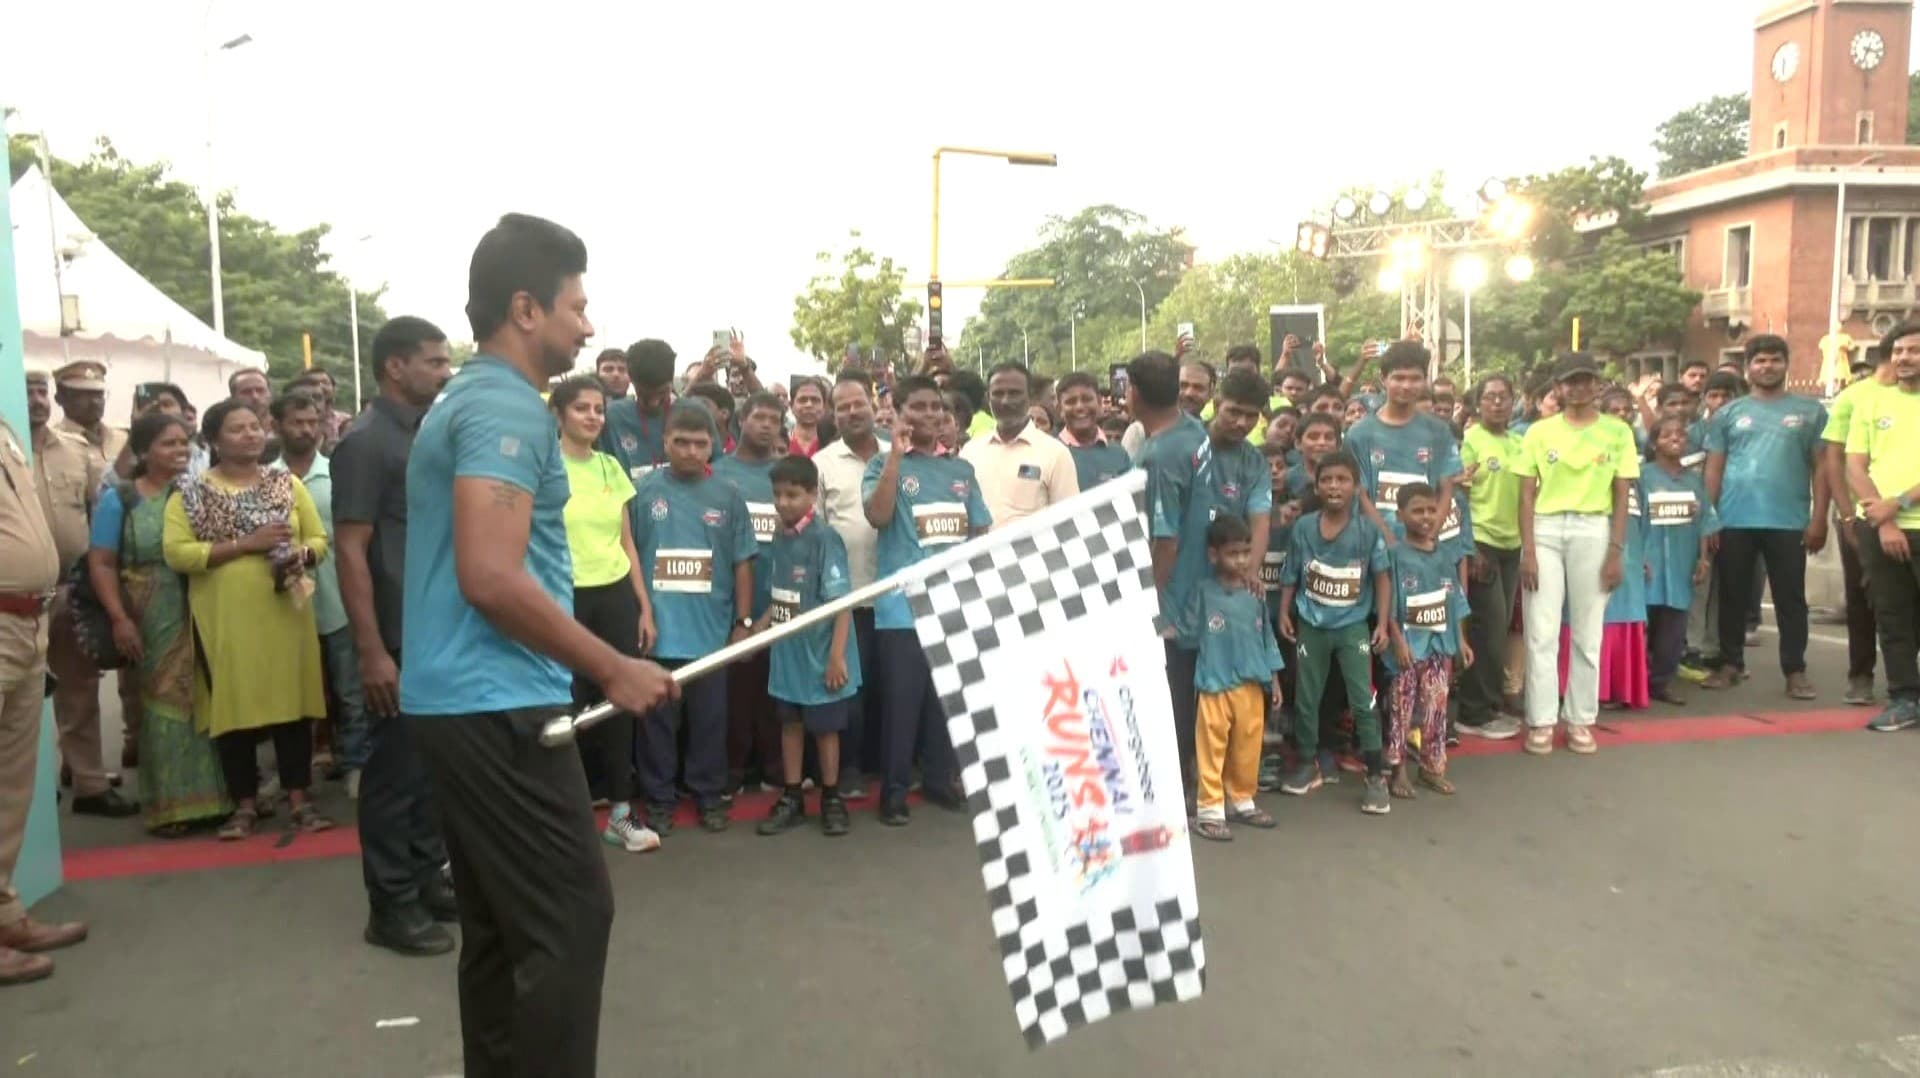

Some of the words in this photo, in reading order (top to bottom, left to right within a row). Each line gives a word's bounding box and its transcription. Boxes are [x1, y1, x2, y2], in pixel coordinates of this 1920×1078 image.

[751, 517, 776, 532] 005
[925, 517, 960, 534] 60007
[1313, 577, 1349, 597] 60038
[1042, 658, 1106, 808] RUNS
[1083, 687, 1134, 815] CHENNAI
